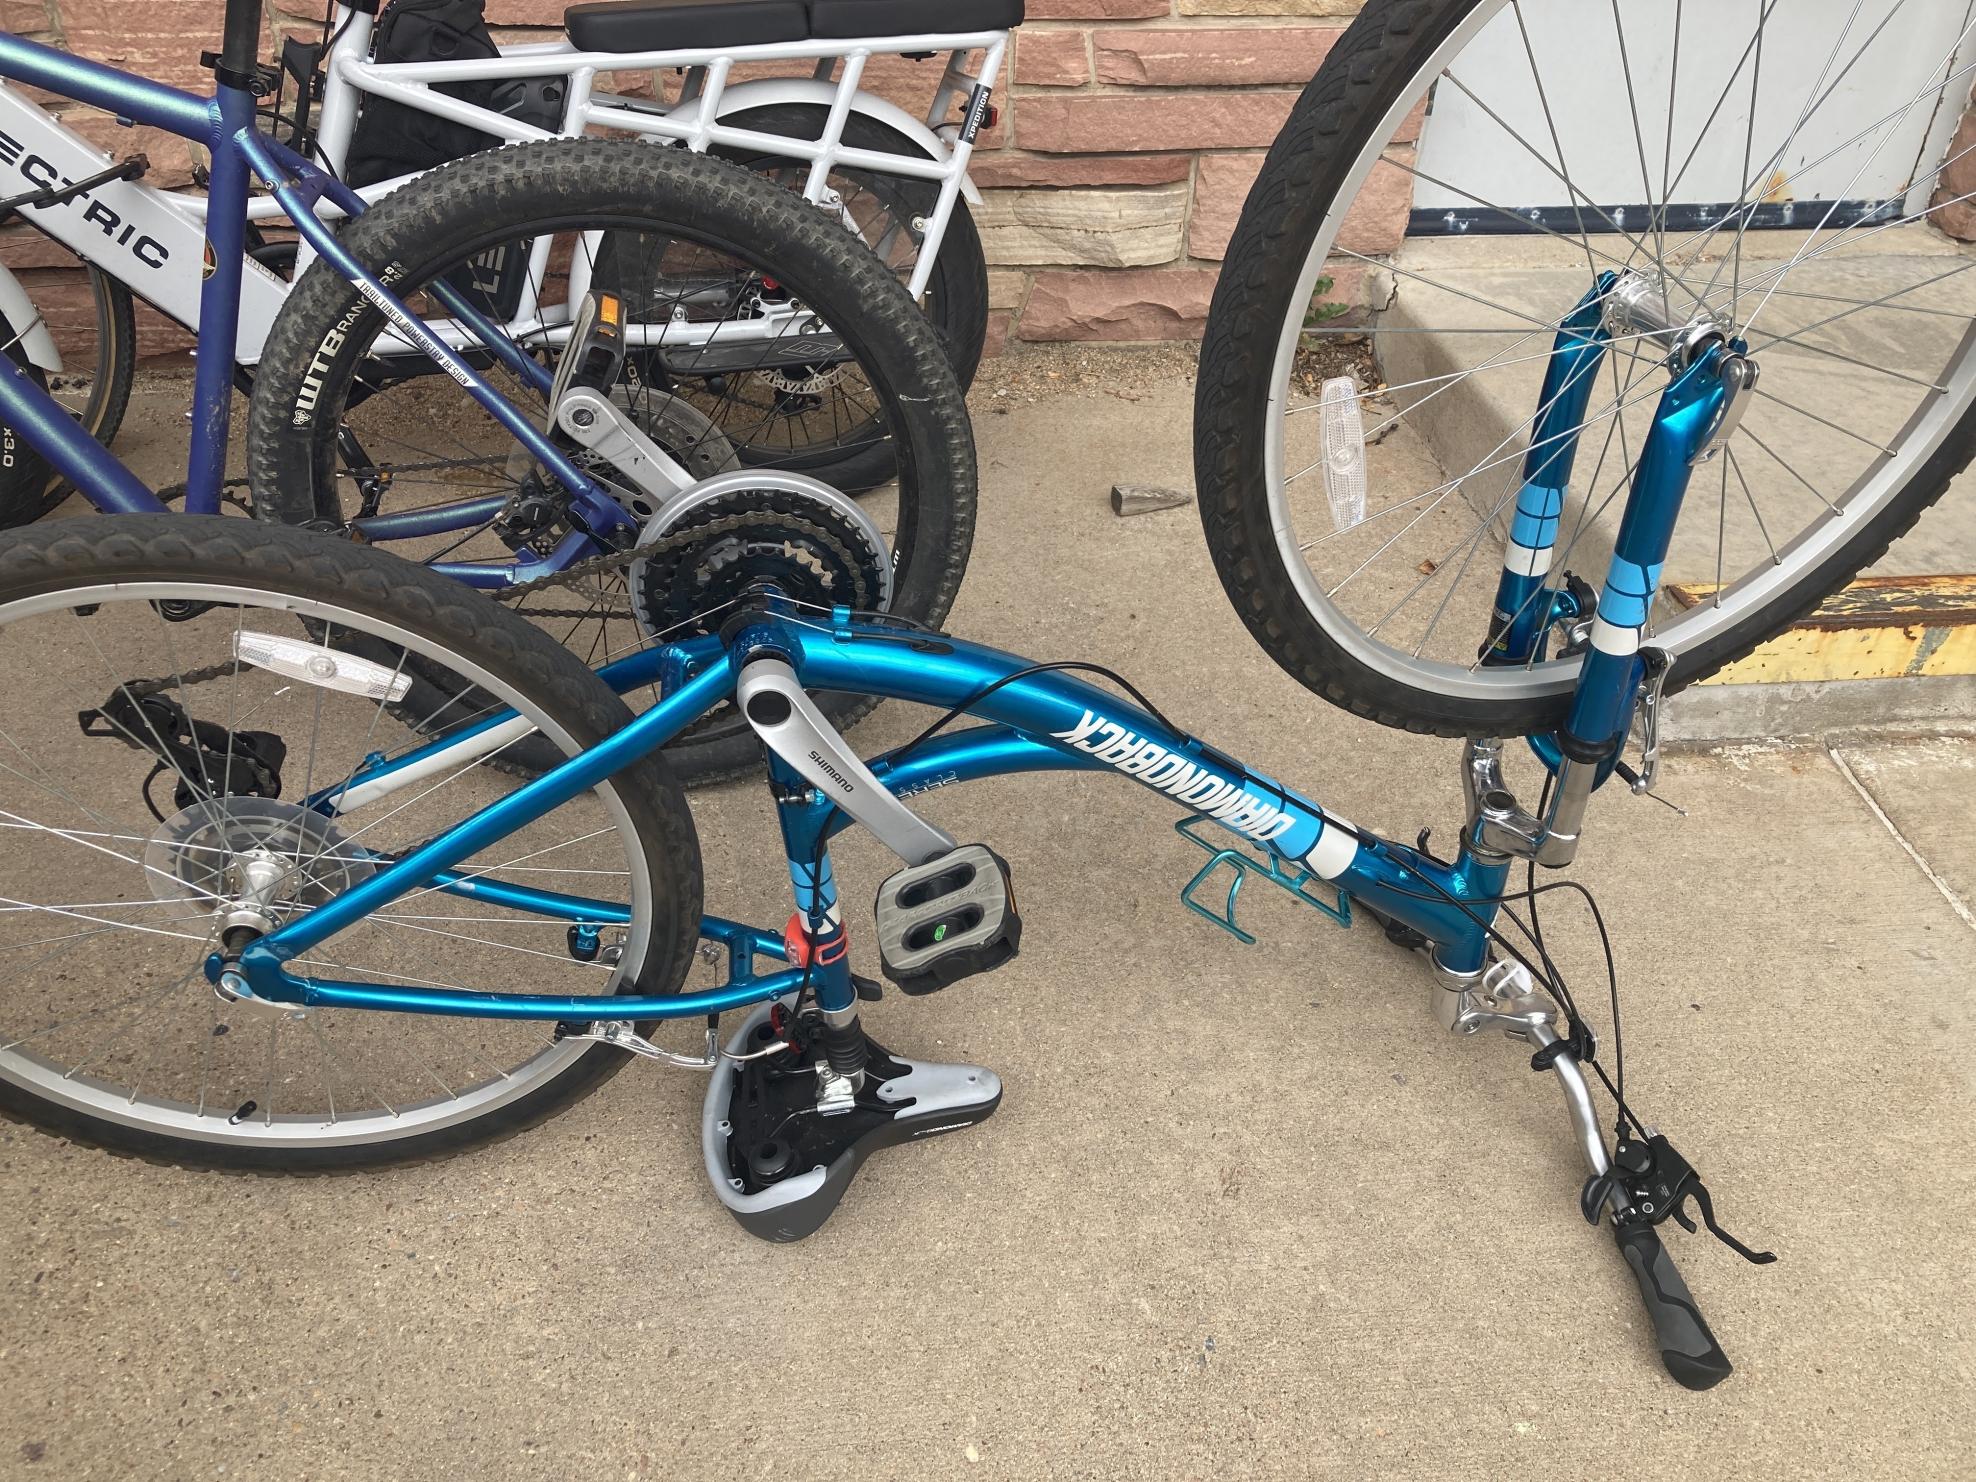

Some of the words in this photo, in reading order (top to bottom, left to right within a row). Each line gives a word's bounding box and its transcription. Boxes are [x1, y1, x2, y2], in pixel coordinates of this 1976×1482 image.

[968, 91, 989, 139] XPEDITION
[296, 328, 344, 410] WTB
[444, 358, 470, 385] DESIGN
[808, 750, 855, 793] SHIMANO
[1049, 709, 1296, 841] DIAMONDBACK
